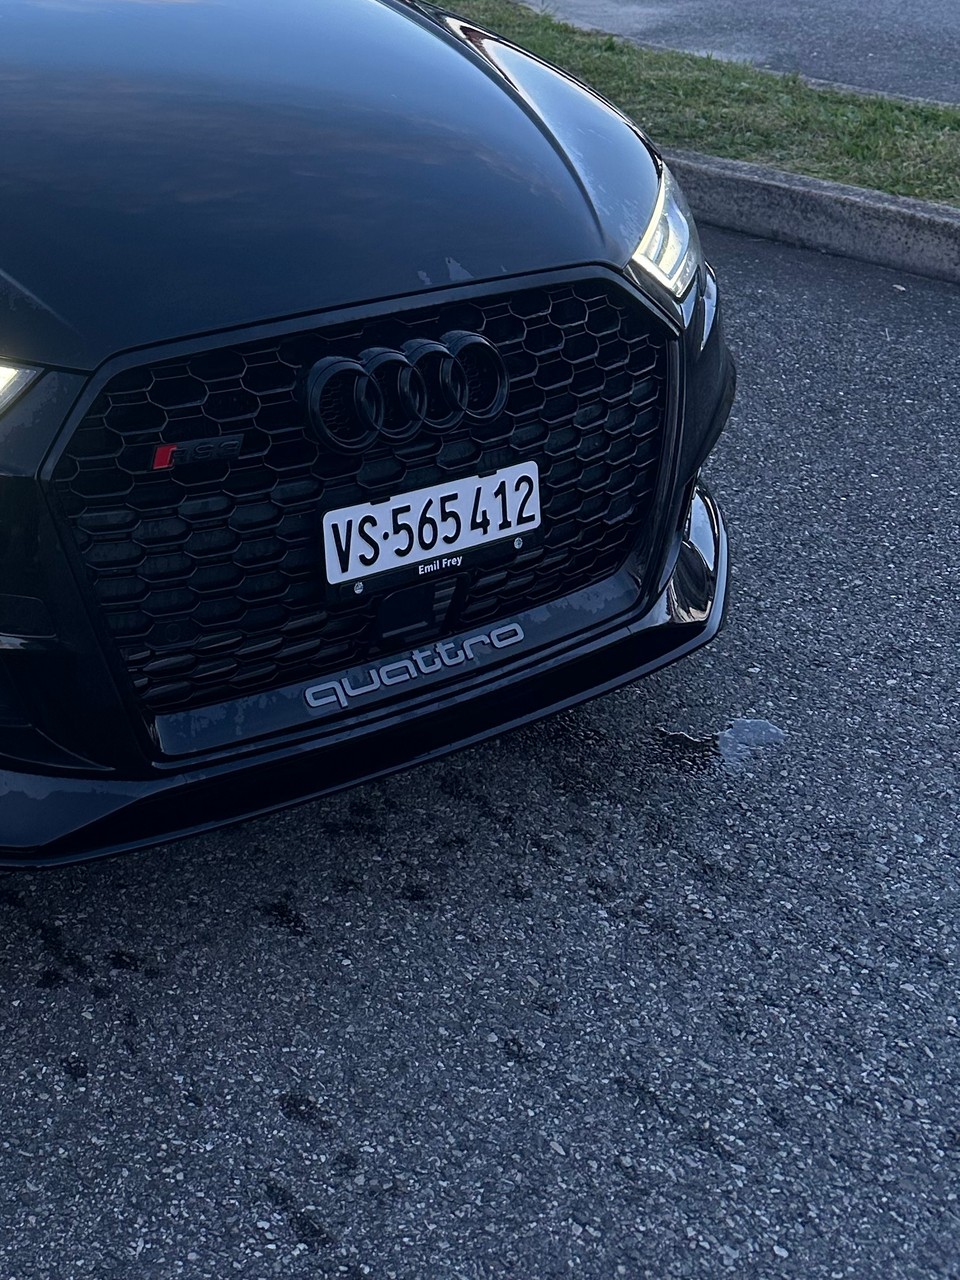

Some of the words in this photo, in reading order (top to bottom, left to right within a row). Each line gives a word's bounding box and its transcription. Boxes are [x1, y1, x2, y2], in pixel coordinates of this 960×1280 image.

[418, 559, 440, 575] Emil
[442, 556, 463, 568] Frey
[304, 623, 525, 708] quattro
